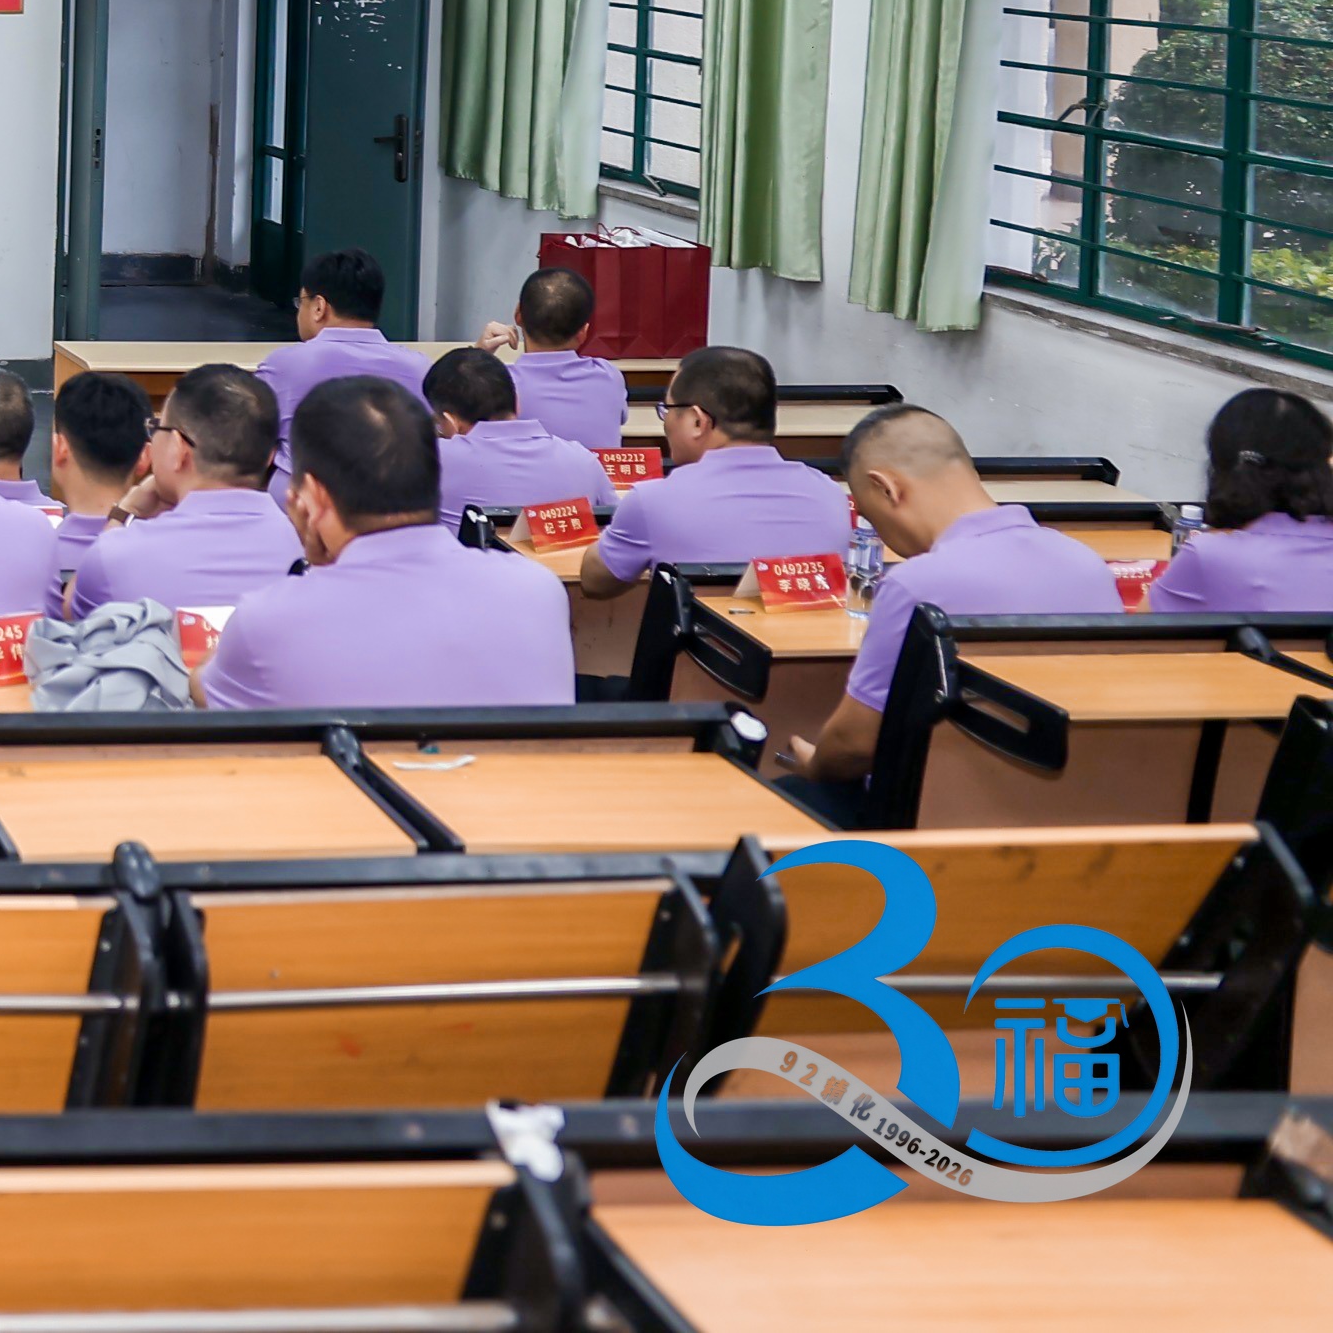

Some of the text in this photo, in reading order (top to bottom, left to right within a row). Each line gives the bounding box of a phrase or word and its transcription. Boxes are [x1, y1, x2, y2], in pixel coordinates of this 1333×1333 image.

[603, 453, 645, 463] 0492212
[539, 506, 578, 520] 0492224
[773, 561, 825, 576] 0492235
